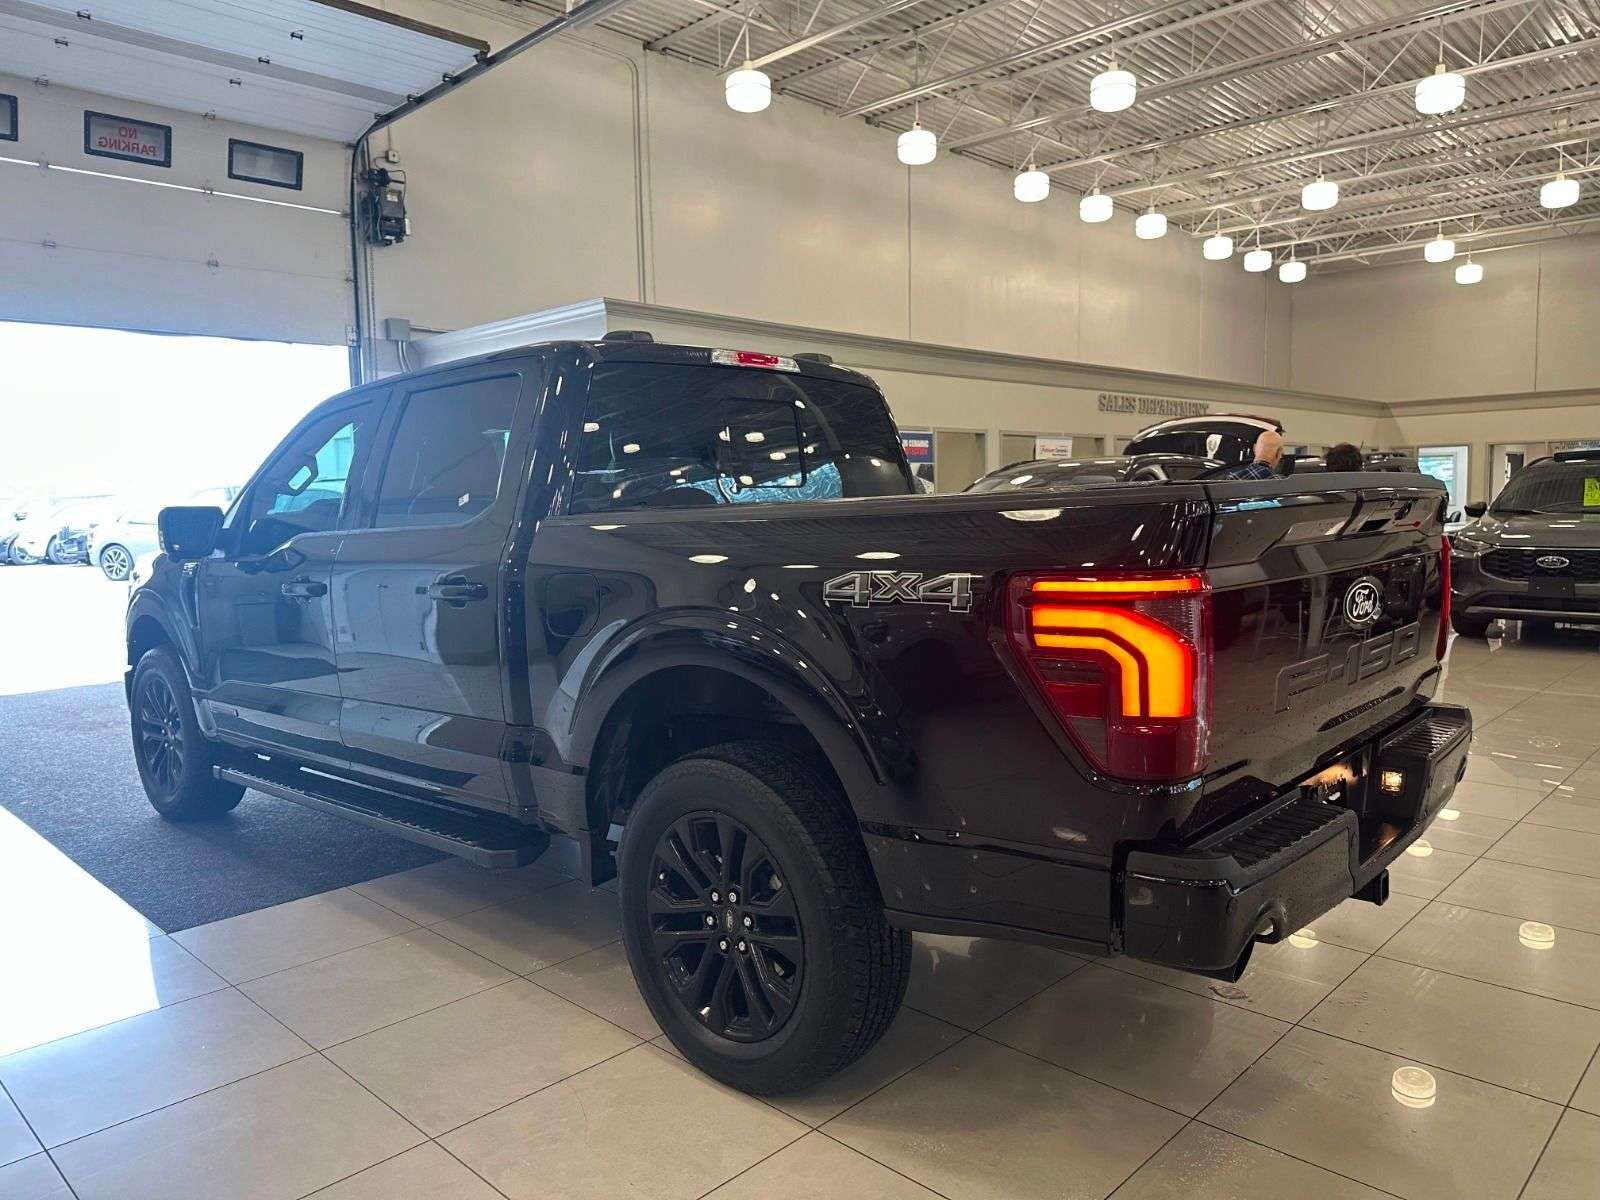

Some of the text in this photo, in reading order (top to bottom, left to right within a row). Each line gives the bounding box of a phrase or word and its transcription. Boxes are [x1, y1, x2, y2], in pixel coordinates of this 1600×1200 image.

[1099, 393, 1209, 416] SALES DEPARTMENT
[1352, 588, 1375, 617] Ford
